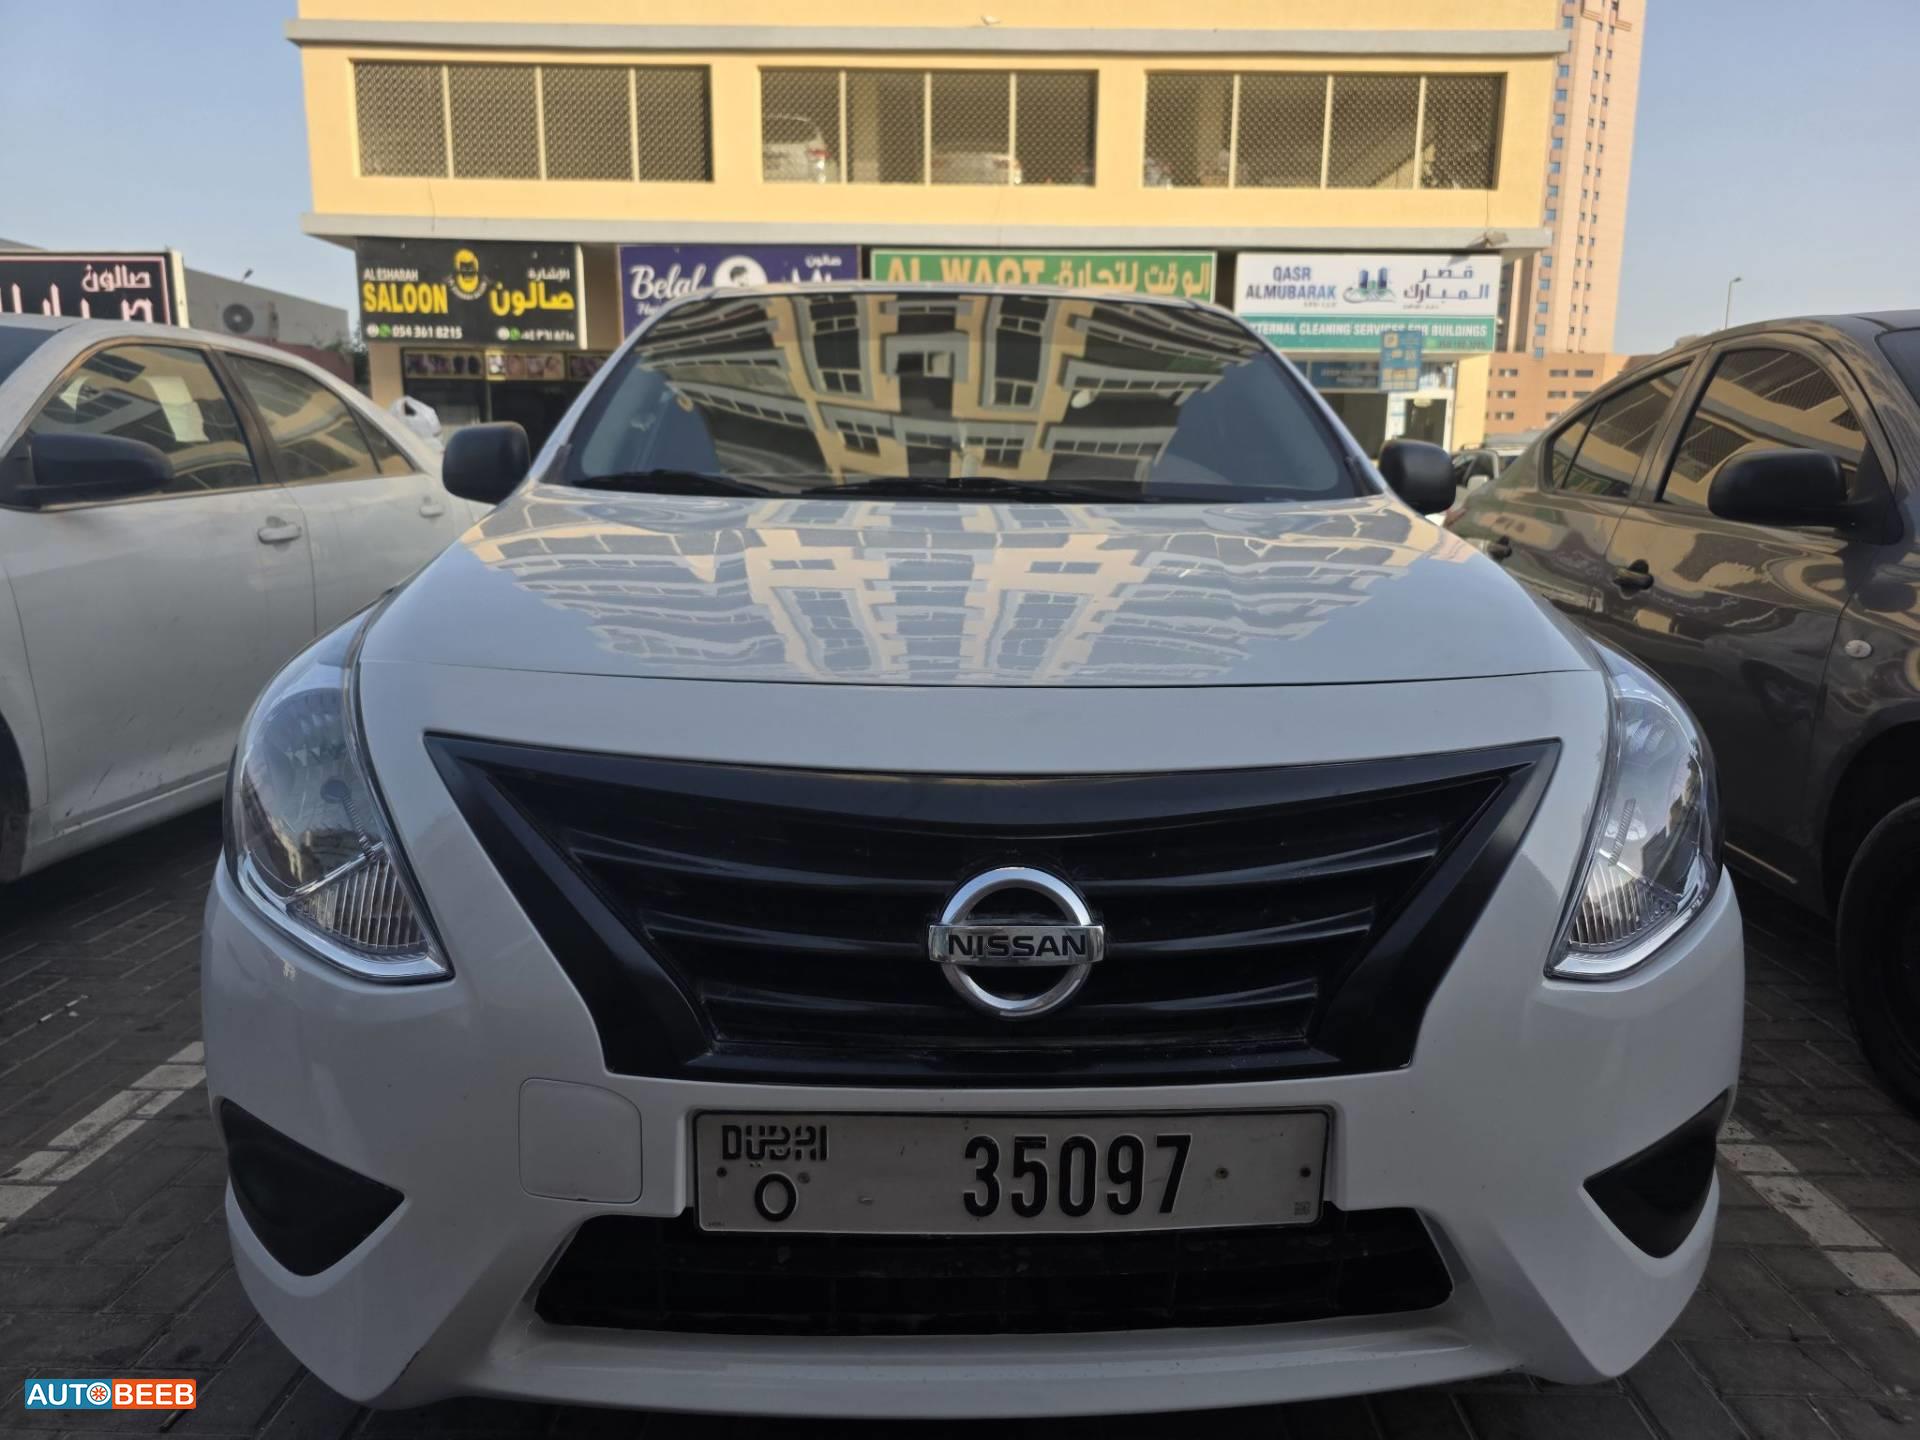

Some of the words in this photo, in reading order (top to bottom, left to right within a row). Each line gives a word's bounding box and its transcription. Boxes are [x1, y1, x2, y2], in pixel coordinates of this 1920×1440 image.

[805, 253, 843, 269] صالون
[887, 257, 921, 284] AL
[940, 257, 1045, 286] WAQT
[1272, 265, 1311, 281] QASR
[1420, 264, 1474, 283] قصر
[81, 264, 152, 292] صالون
[631, 263, 707, 300] Belal
[1143, 261, 1211, 299] الوقت
[362, 282, 449, 314] SALOON
[489, 281, 575, 317] صالون
[1245, 284, 1337, 301] ALMUBARAK
[1403, 283, 1490, 304] المبارك
[1248, 321, 1297, 336] XTERNAL
[1299, 322, 1351, 337] CLEANING
[1431, 323, 1488, 338] BUILDINGS
[947, 933, 1087, 957] NISSAN
[721, 1124, 828, 1161] DUBAI
[962, 1133, 1193, 1219] 35097
